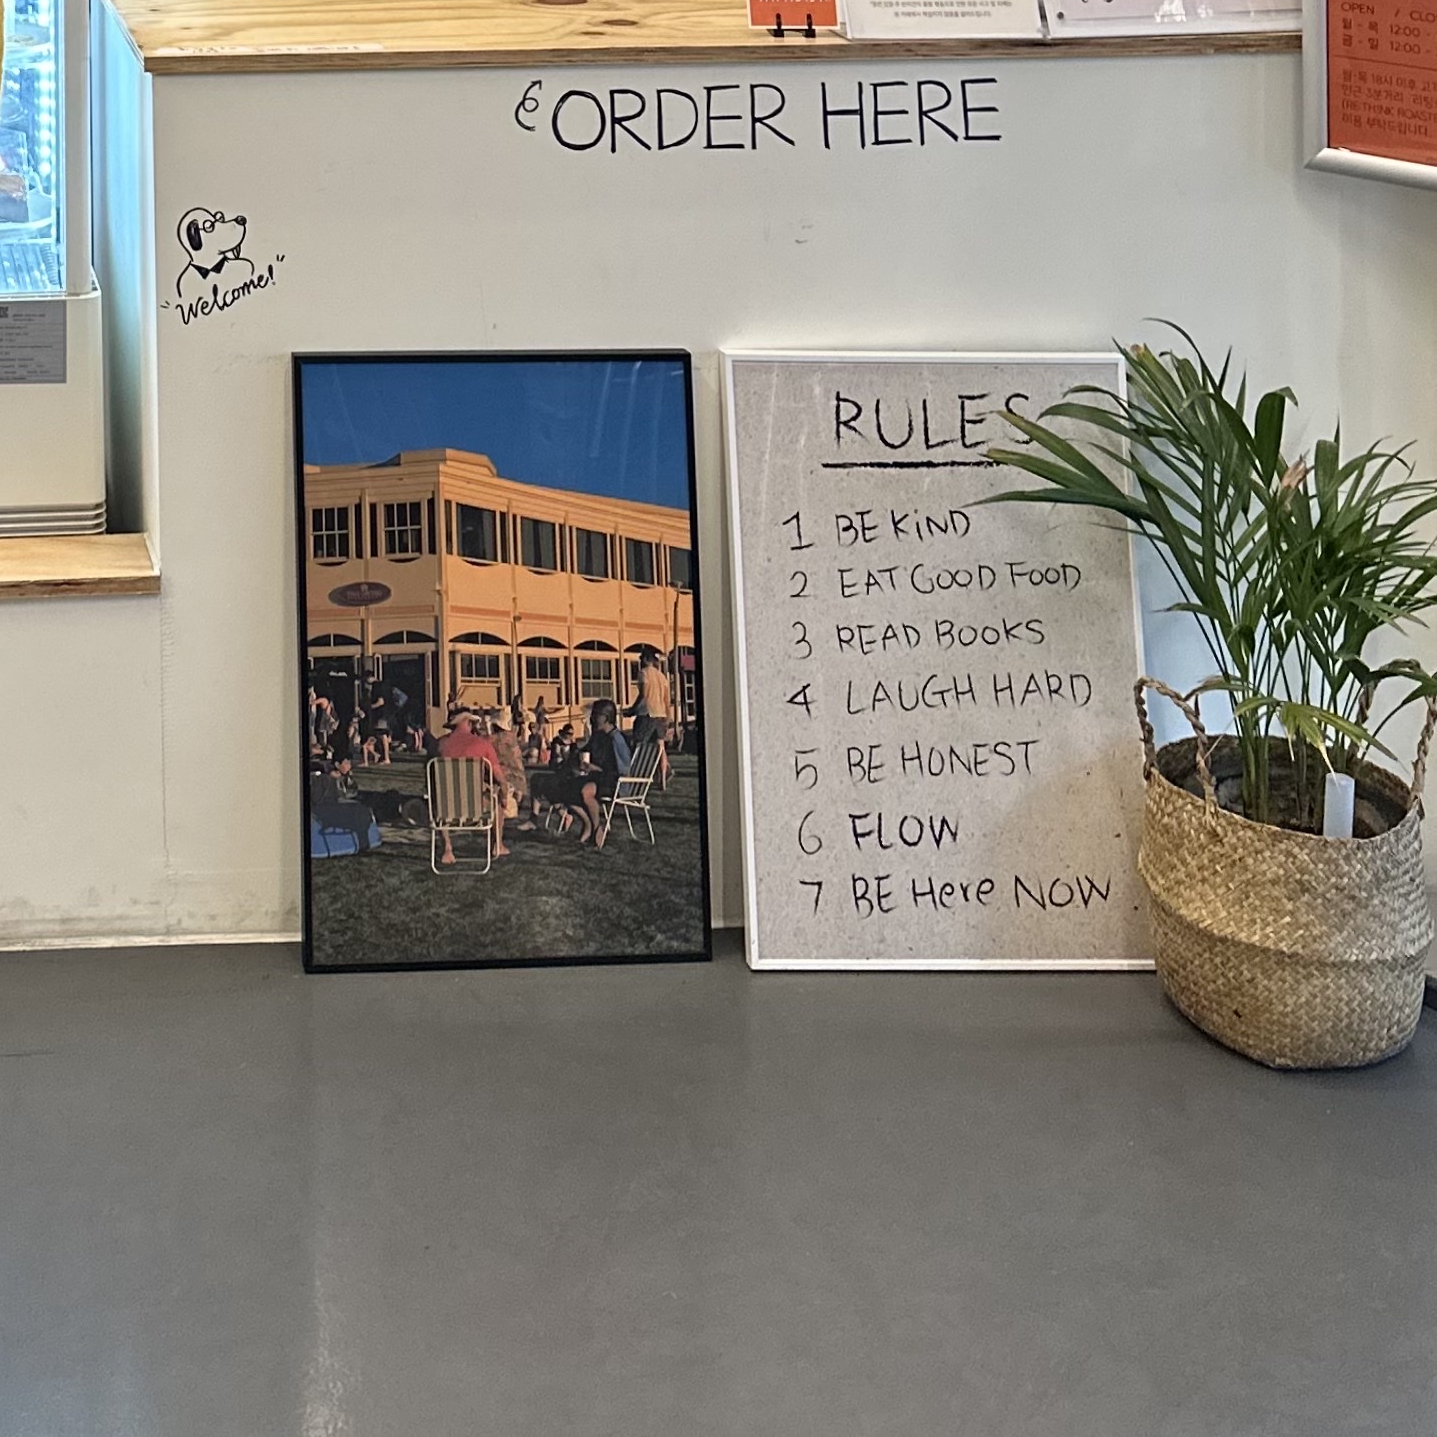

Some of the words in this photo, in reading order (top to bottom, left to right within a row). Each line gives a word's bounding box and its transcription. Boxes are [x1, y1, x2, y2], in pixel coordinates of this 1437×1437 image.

[1341, 1, 1375, 15] OPEN
[1389, 24, 1421, 38] 12:00
[1389, 41, 1421, 54] 12:00
[552, 84, 796, 153] ORDER
[821, 78, 1002, 149] HERE
[835, 390, 1037, 450] RULES
[782, 511, 815, 550] 1
[836, 510, 879, 547] BE
[790, 571, 812, 598] 2
[840, 566, 899, 598] EAT
[911, 563, 996, 595] GOOD
[792, 621, 812, 660] 3
[837, 622, 920, 655] READ
[936, 618, 1046, 648] BOOKS
[787, 683, 815, 718] 4
[847, 674, 977, 715] LAUGH
[994, 669, 1093, 708] HARD
[795, 748, 818, 790] 5
[847, 745, 885, 785] BE
[900, 740, 1041, 778] HONEST
[798, 810, 824, 855] 6
[849, 812, 961, 850] FLOW
[799, 880, 824, 915] 7
[853, 874, 898, 919] BE
[1015, 874, 1112, 912] NOW
